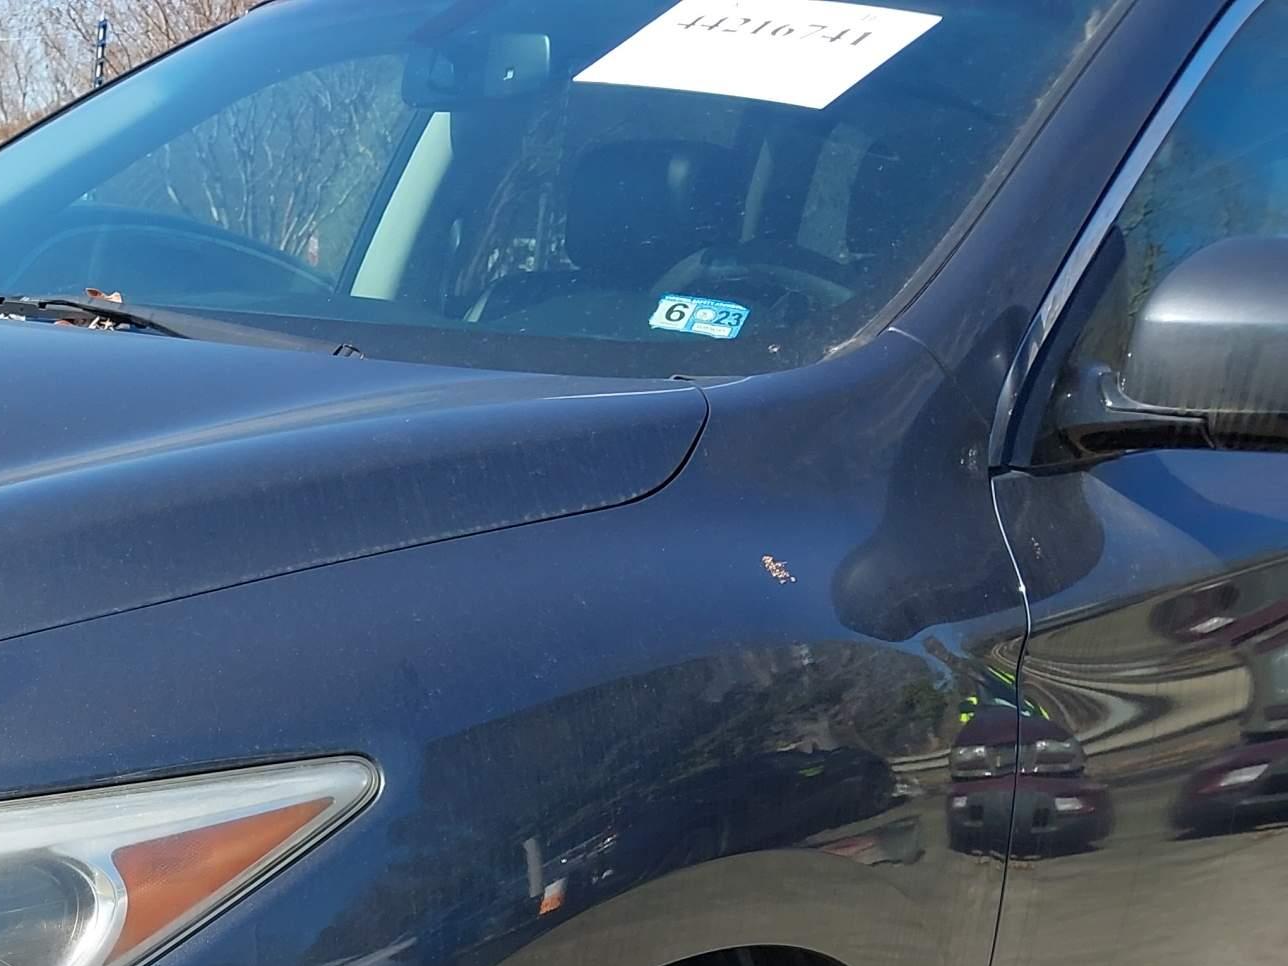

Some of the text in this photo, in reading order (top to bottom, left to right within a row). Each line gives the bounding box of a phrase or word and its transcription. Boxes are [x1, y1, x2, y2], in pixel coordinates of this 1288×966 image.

[676, 15, 873, 46] 44216741
[664, 303, 744, 327] 6 23
